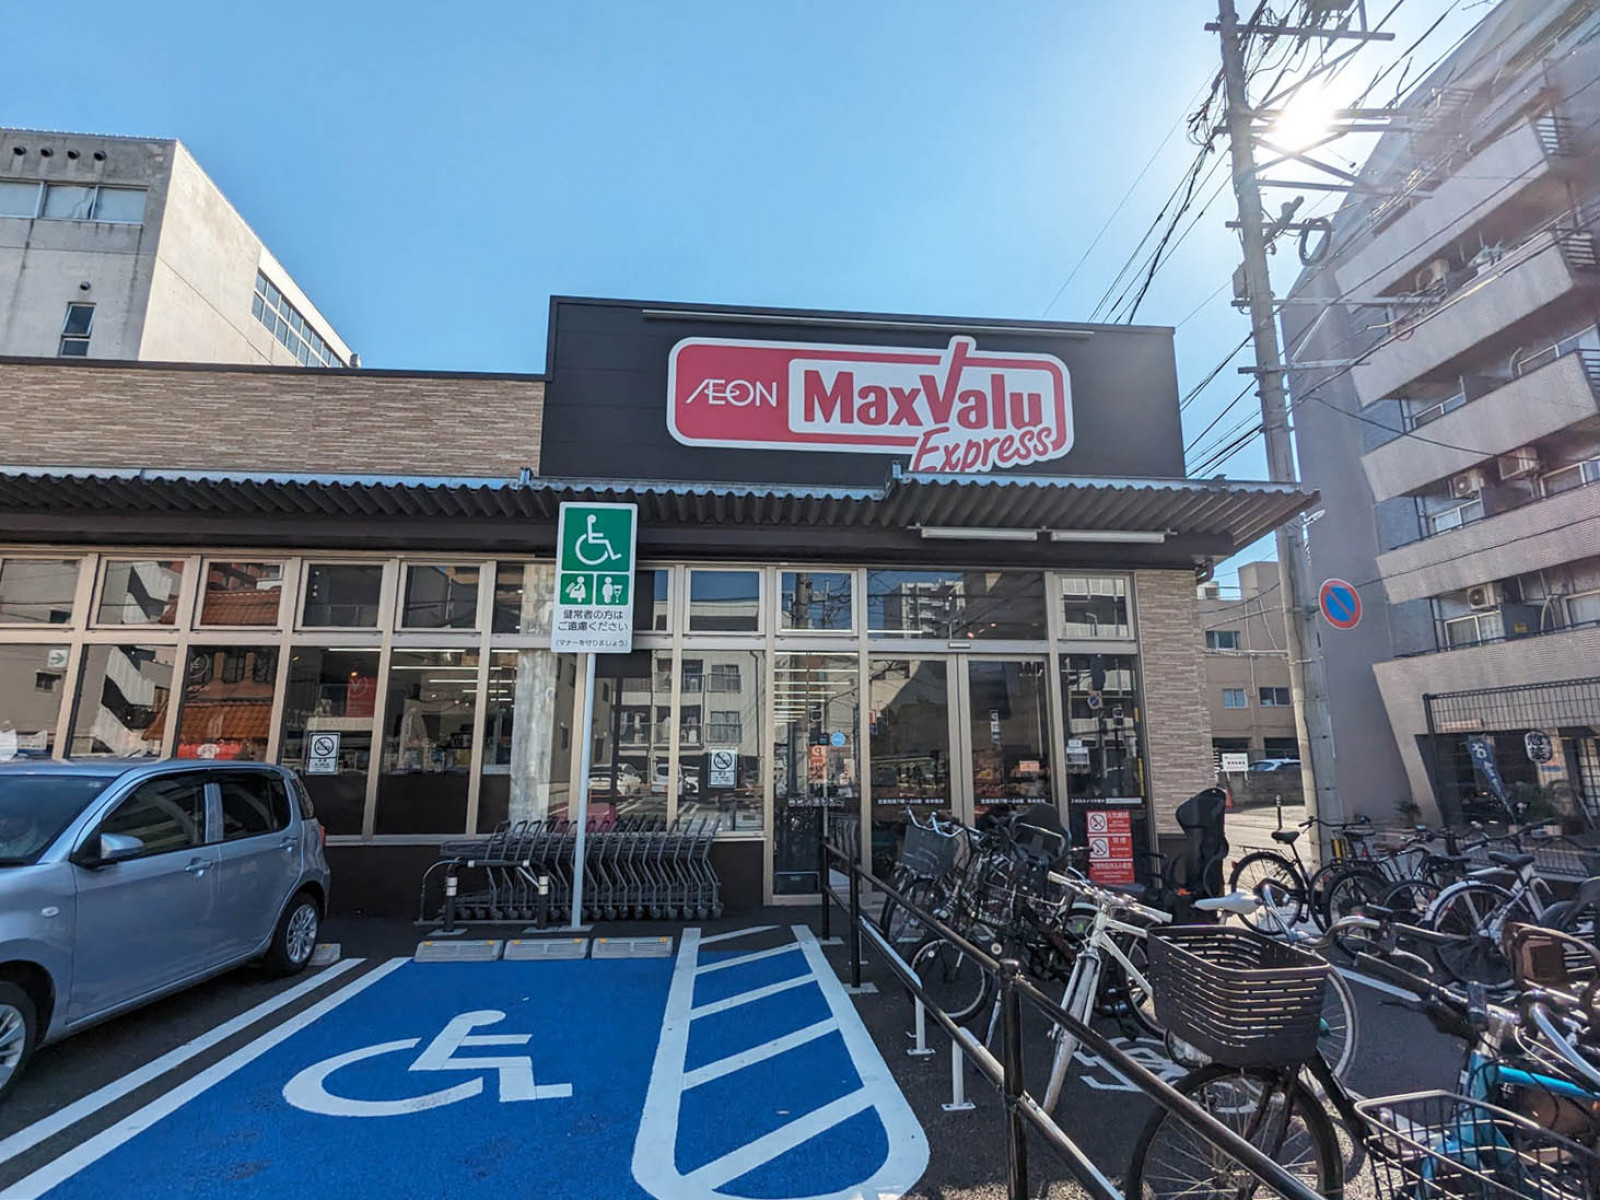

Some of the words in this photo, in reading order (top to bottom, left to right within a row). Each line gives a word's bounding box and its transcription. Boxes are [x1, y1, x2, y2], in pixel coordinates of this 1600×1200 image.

[803, 342, 1043, 431] MaxValu
[912, 426, 1052, 473] Express
[558, 621, 628, 631] ご遠慮ください
[563, 609, 623, 619] 健常者の方は
